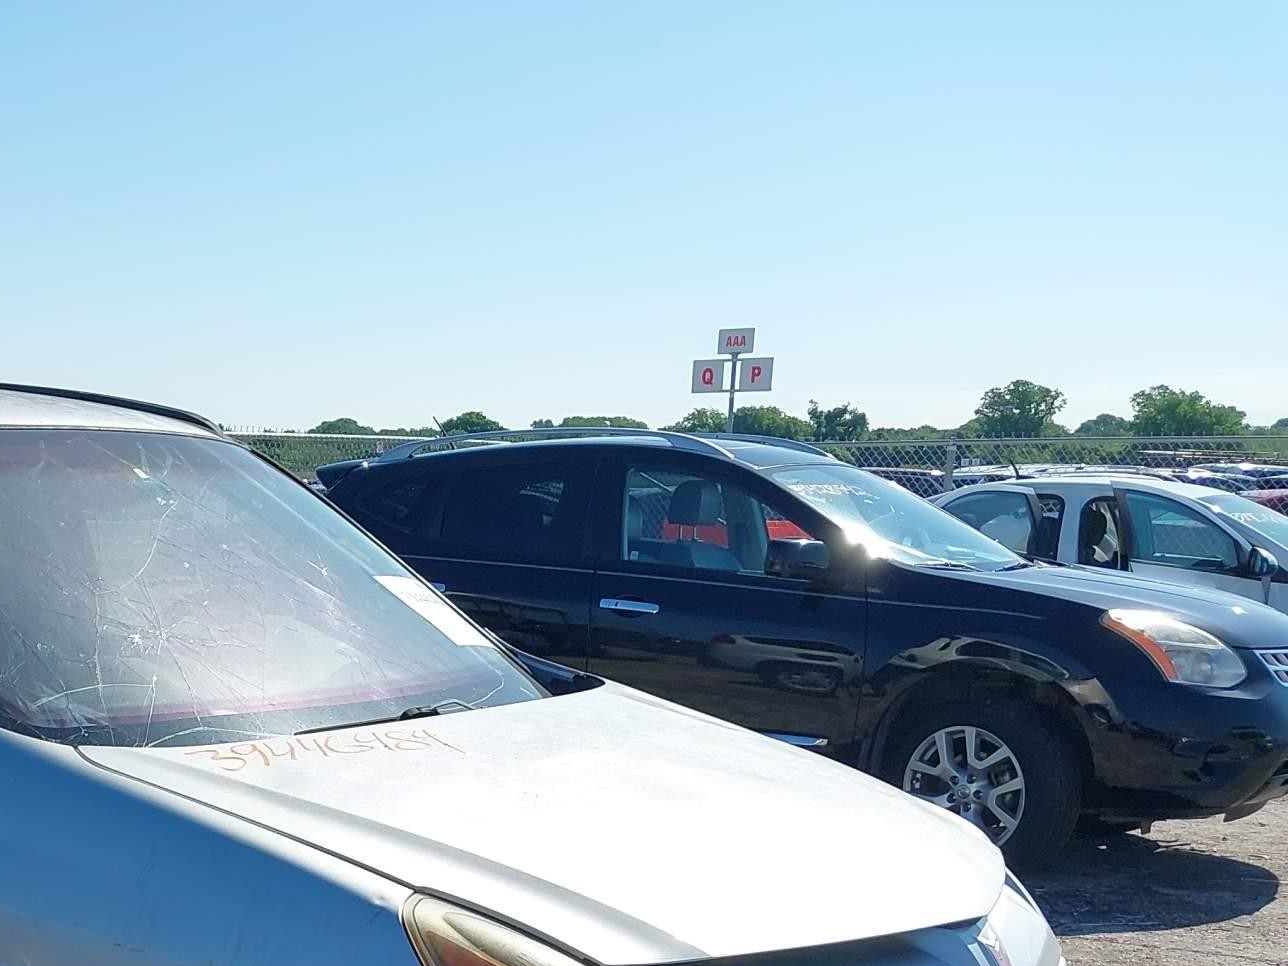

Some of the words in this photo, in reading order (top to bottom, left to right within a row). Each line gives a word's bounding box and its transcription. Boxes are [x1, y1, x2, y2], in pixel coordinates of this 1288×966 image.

[725, 335, 746, 347] AAA
[702, 367, 714, 385] Q
[751, 366, 761, 383] P
